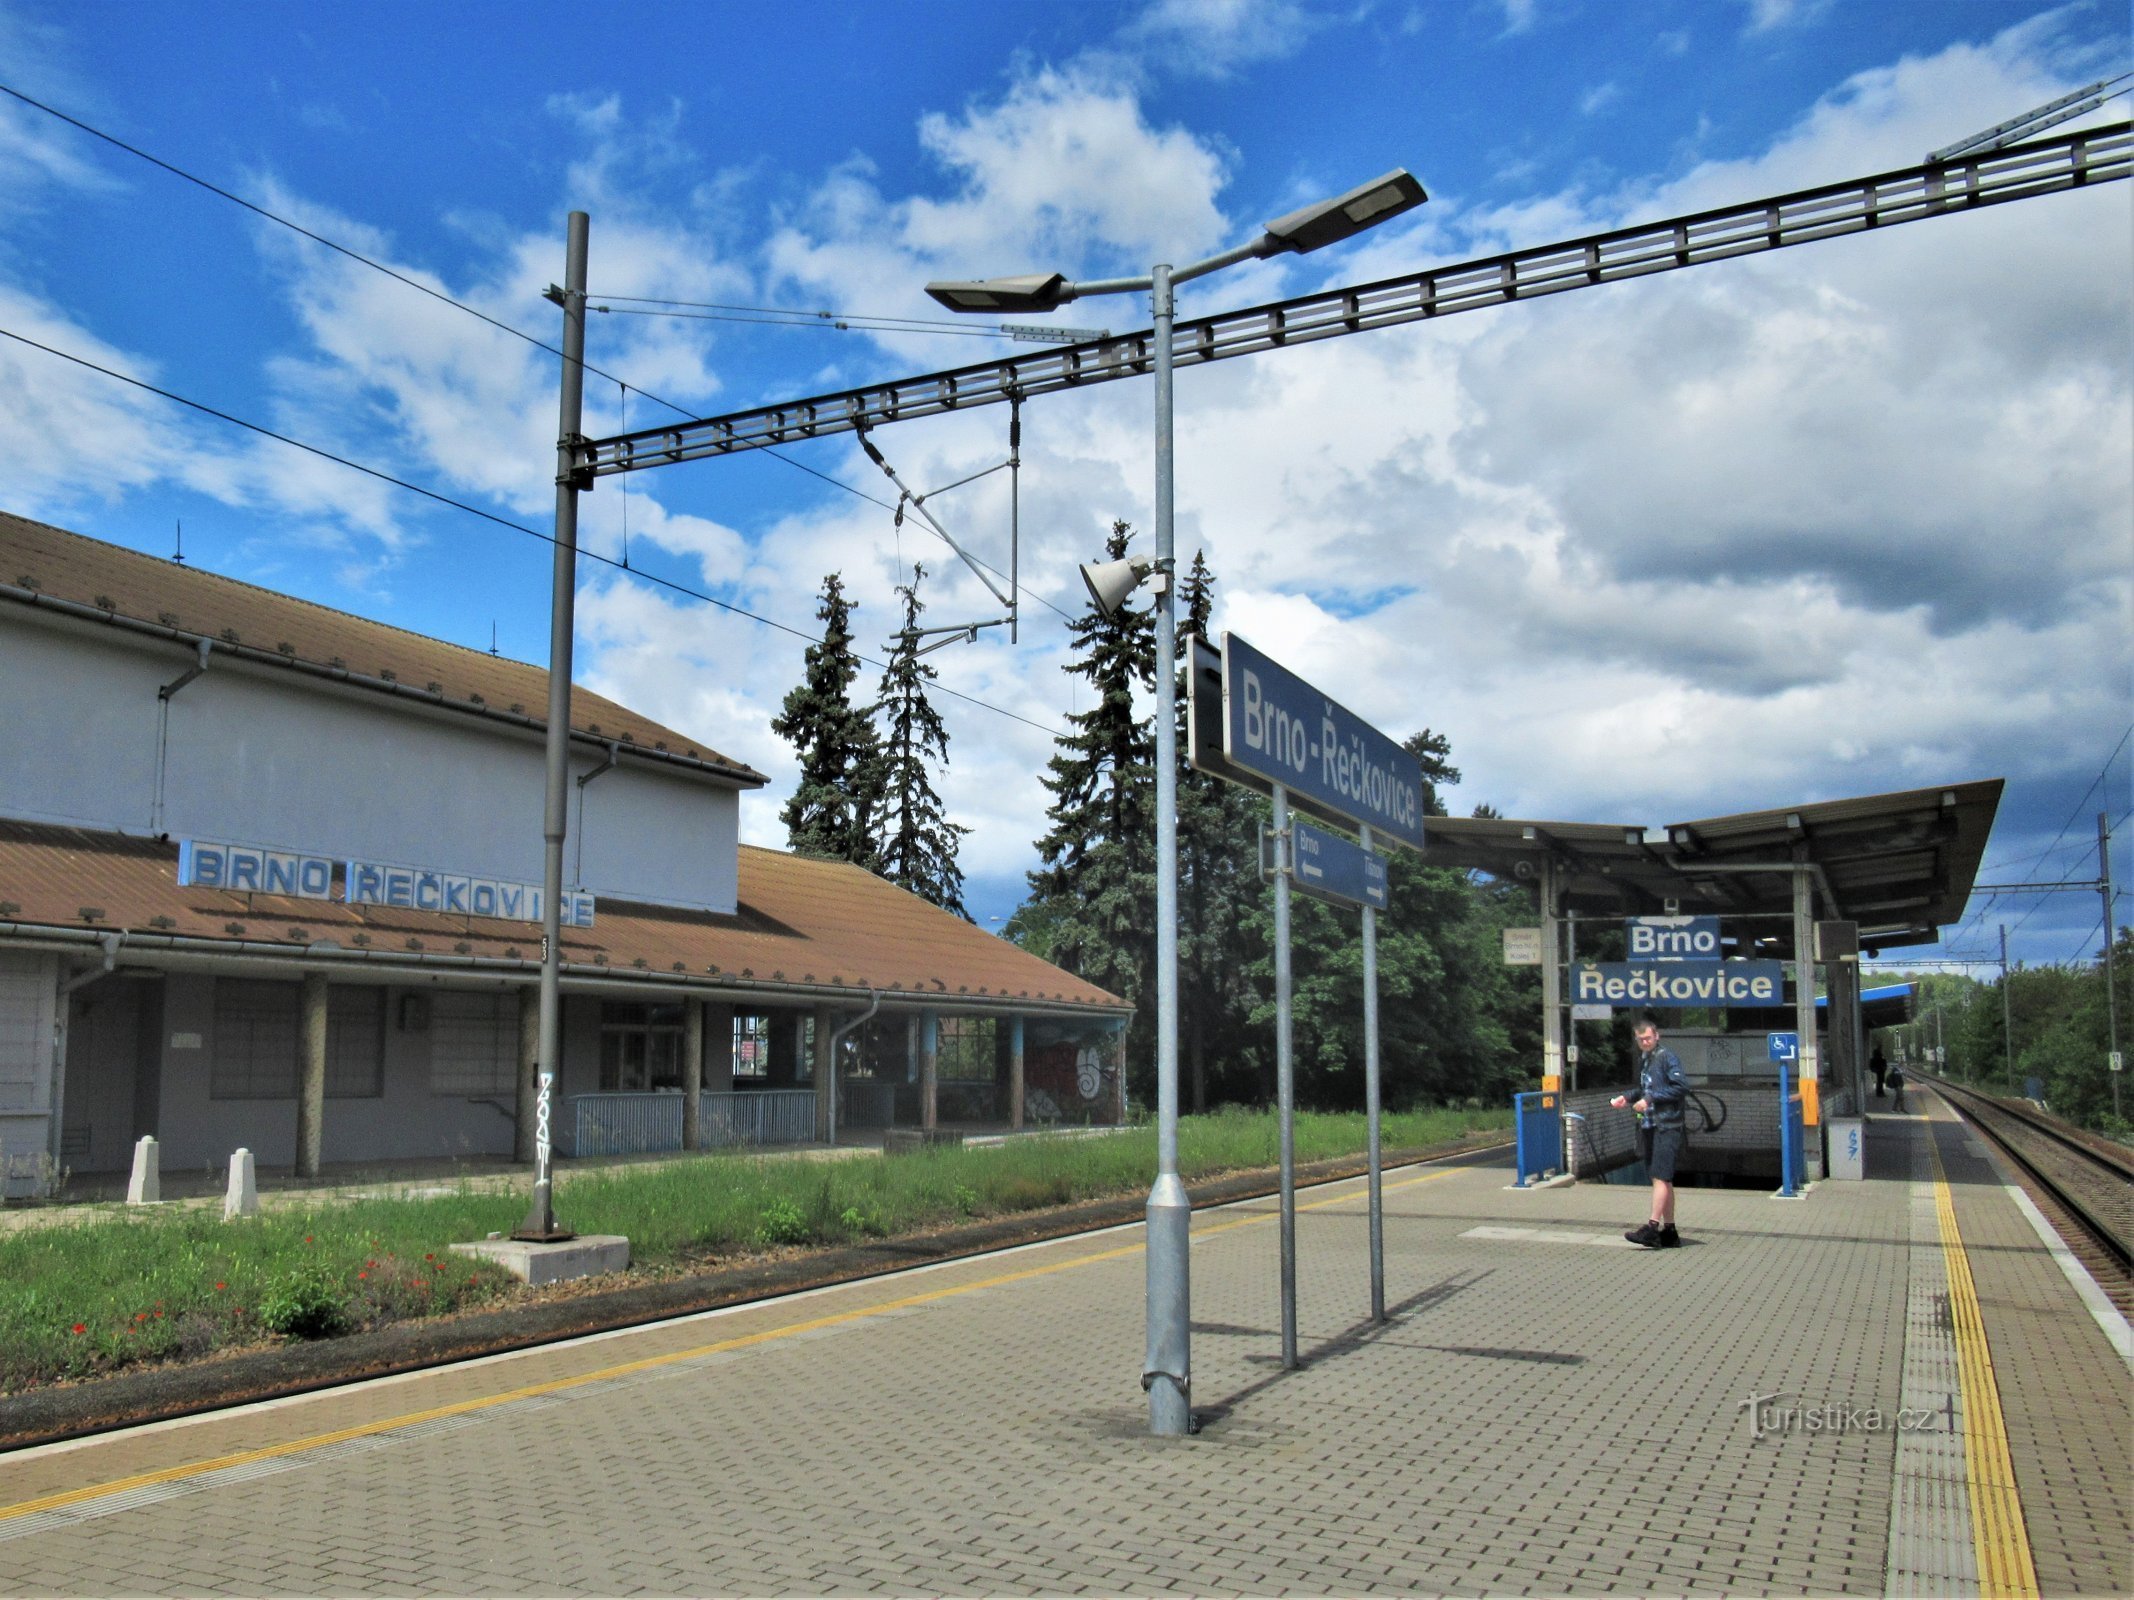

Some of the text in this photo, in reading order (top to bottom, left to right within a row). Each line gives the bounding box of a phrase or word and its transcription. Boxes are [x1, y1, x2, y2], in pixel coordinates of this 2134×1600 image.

[1301, 830, 1319, 856] Brno
[195, 849, 328, 894] BRNO
[1631, 926, 1715, 953] Brno
[1579, 963, 1772, 999] Řečkovice
